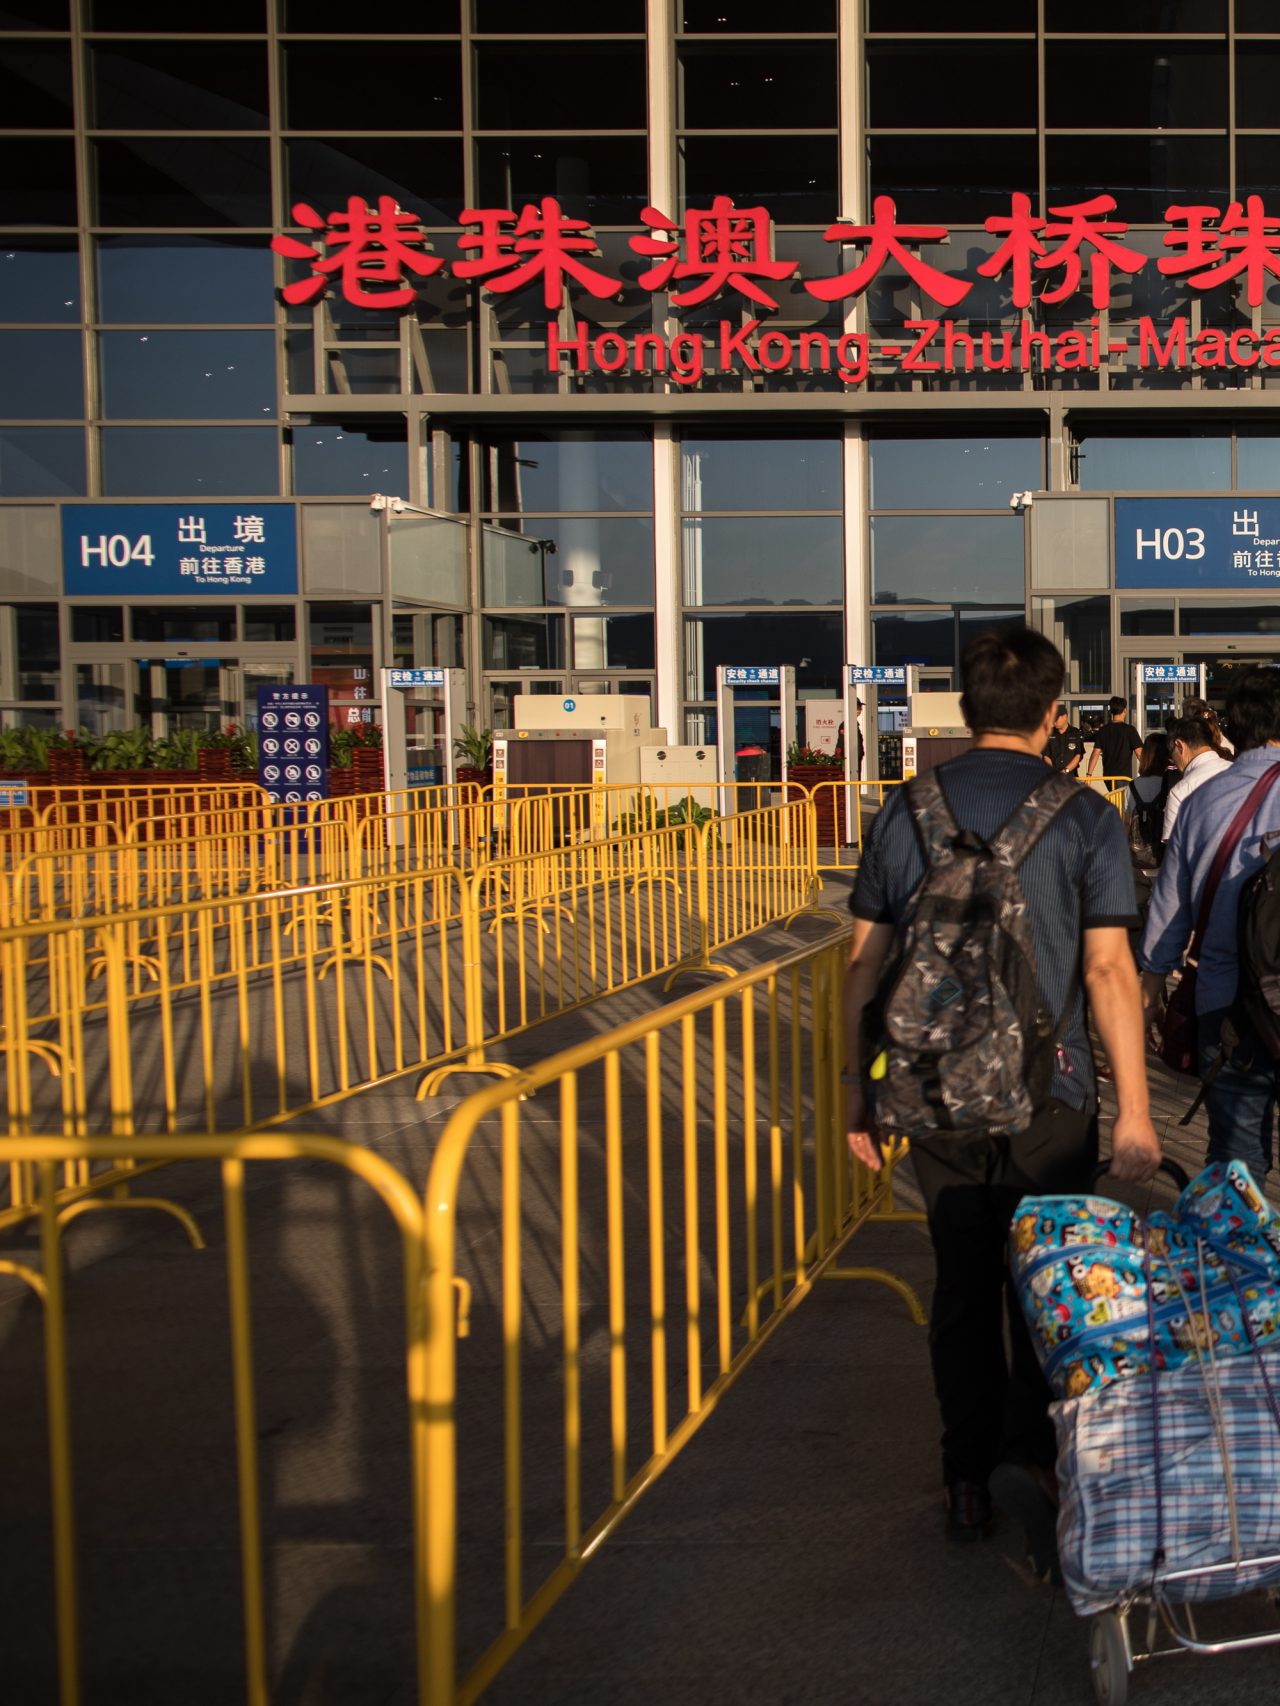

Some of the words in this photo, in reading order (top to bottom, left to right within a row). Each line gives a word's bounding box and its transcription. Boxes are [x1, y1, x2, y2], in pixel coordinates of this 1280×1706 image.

[547, 321, 704, 384] Hong
[199, 544, 245, 553] Departure
[1136, 528, 1205, 560] H03
[80, 534, 155, 567] H04
[179, 557, 265, 575] 前往香港
[1248, 569, 1258, 577] To
[1259, 569, 1280, 577] Hong
[207, 576, 229, 584] Hong
[230, 576, 252, 584] Kong
[727, 669, 747, 679] 安检
[758, 669, 778, 679] 通道
[853, 668, 873, 679] 安检
[884, 668, 904, 679] 通道
[1145, 666, 1165, 677] 安检
[1177, 666, 1197, 677] 通道
